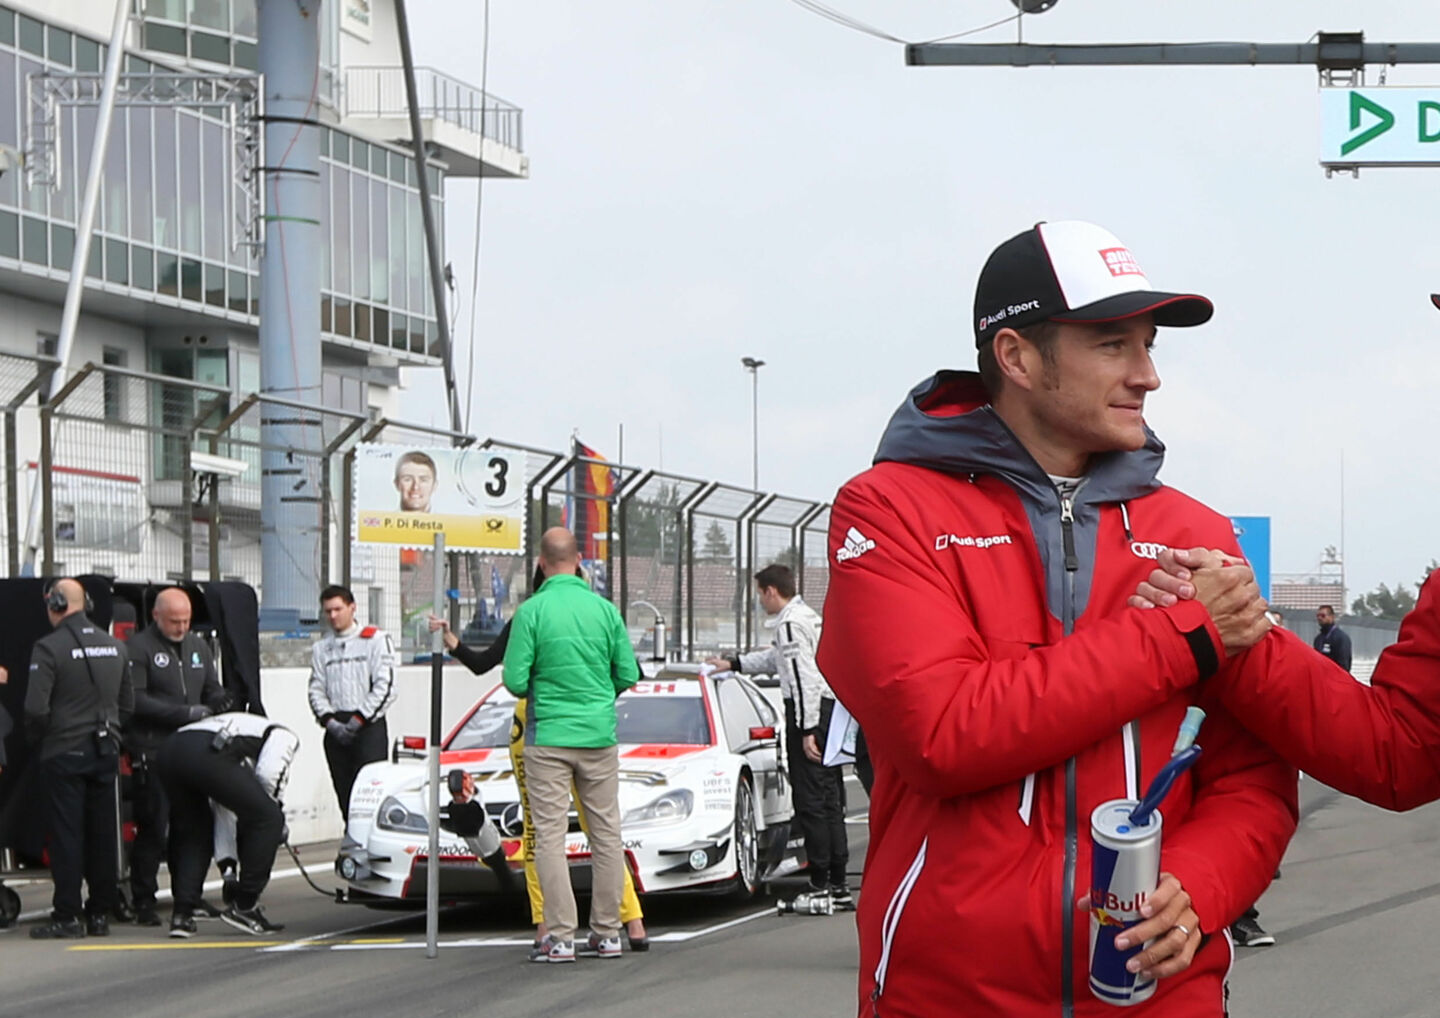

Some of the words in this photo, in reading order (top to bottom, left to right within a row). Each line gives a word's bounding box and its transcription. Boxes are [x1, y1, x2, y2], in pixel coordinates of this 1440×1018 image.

[987, 311, 1007, 325] Audi
[1007, 299, 1040, 317] Sport
[484, 457, 509, 498] 3
[384, 518, 393, 529] P.
[397, 519, 409, 529] Di
[413, 519, 443, 531] Resta
[950, 533, 974, 546] Audi
[975, 534, 1012, 548] Sport
[1105, 891, 1147, 912] Bull
